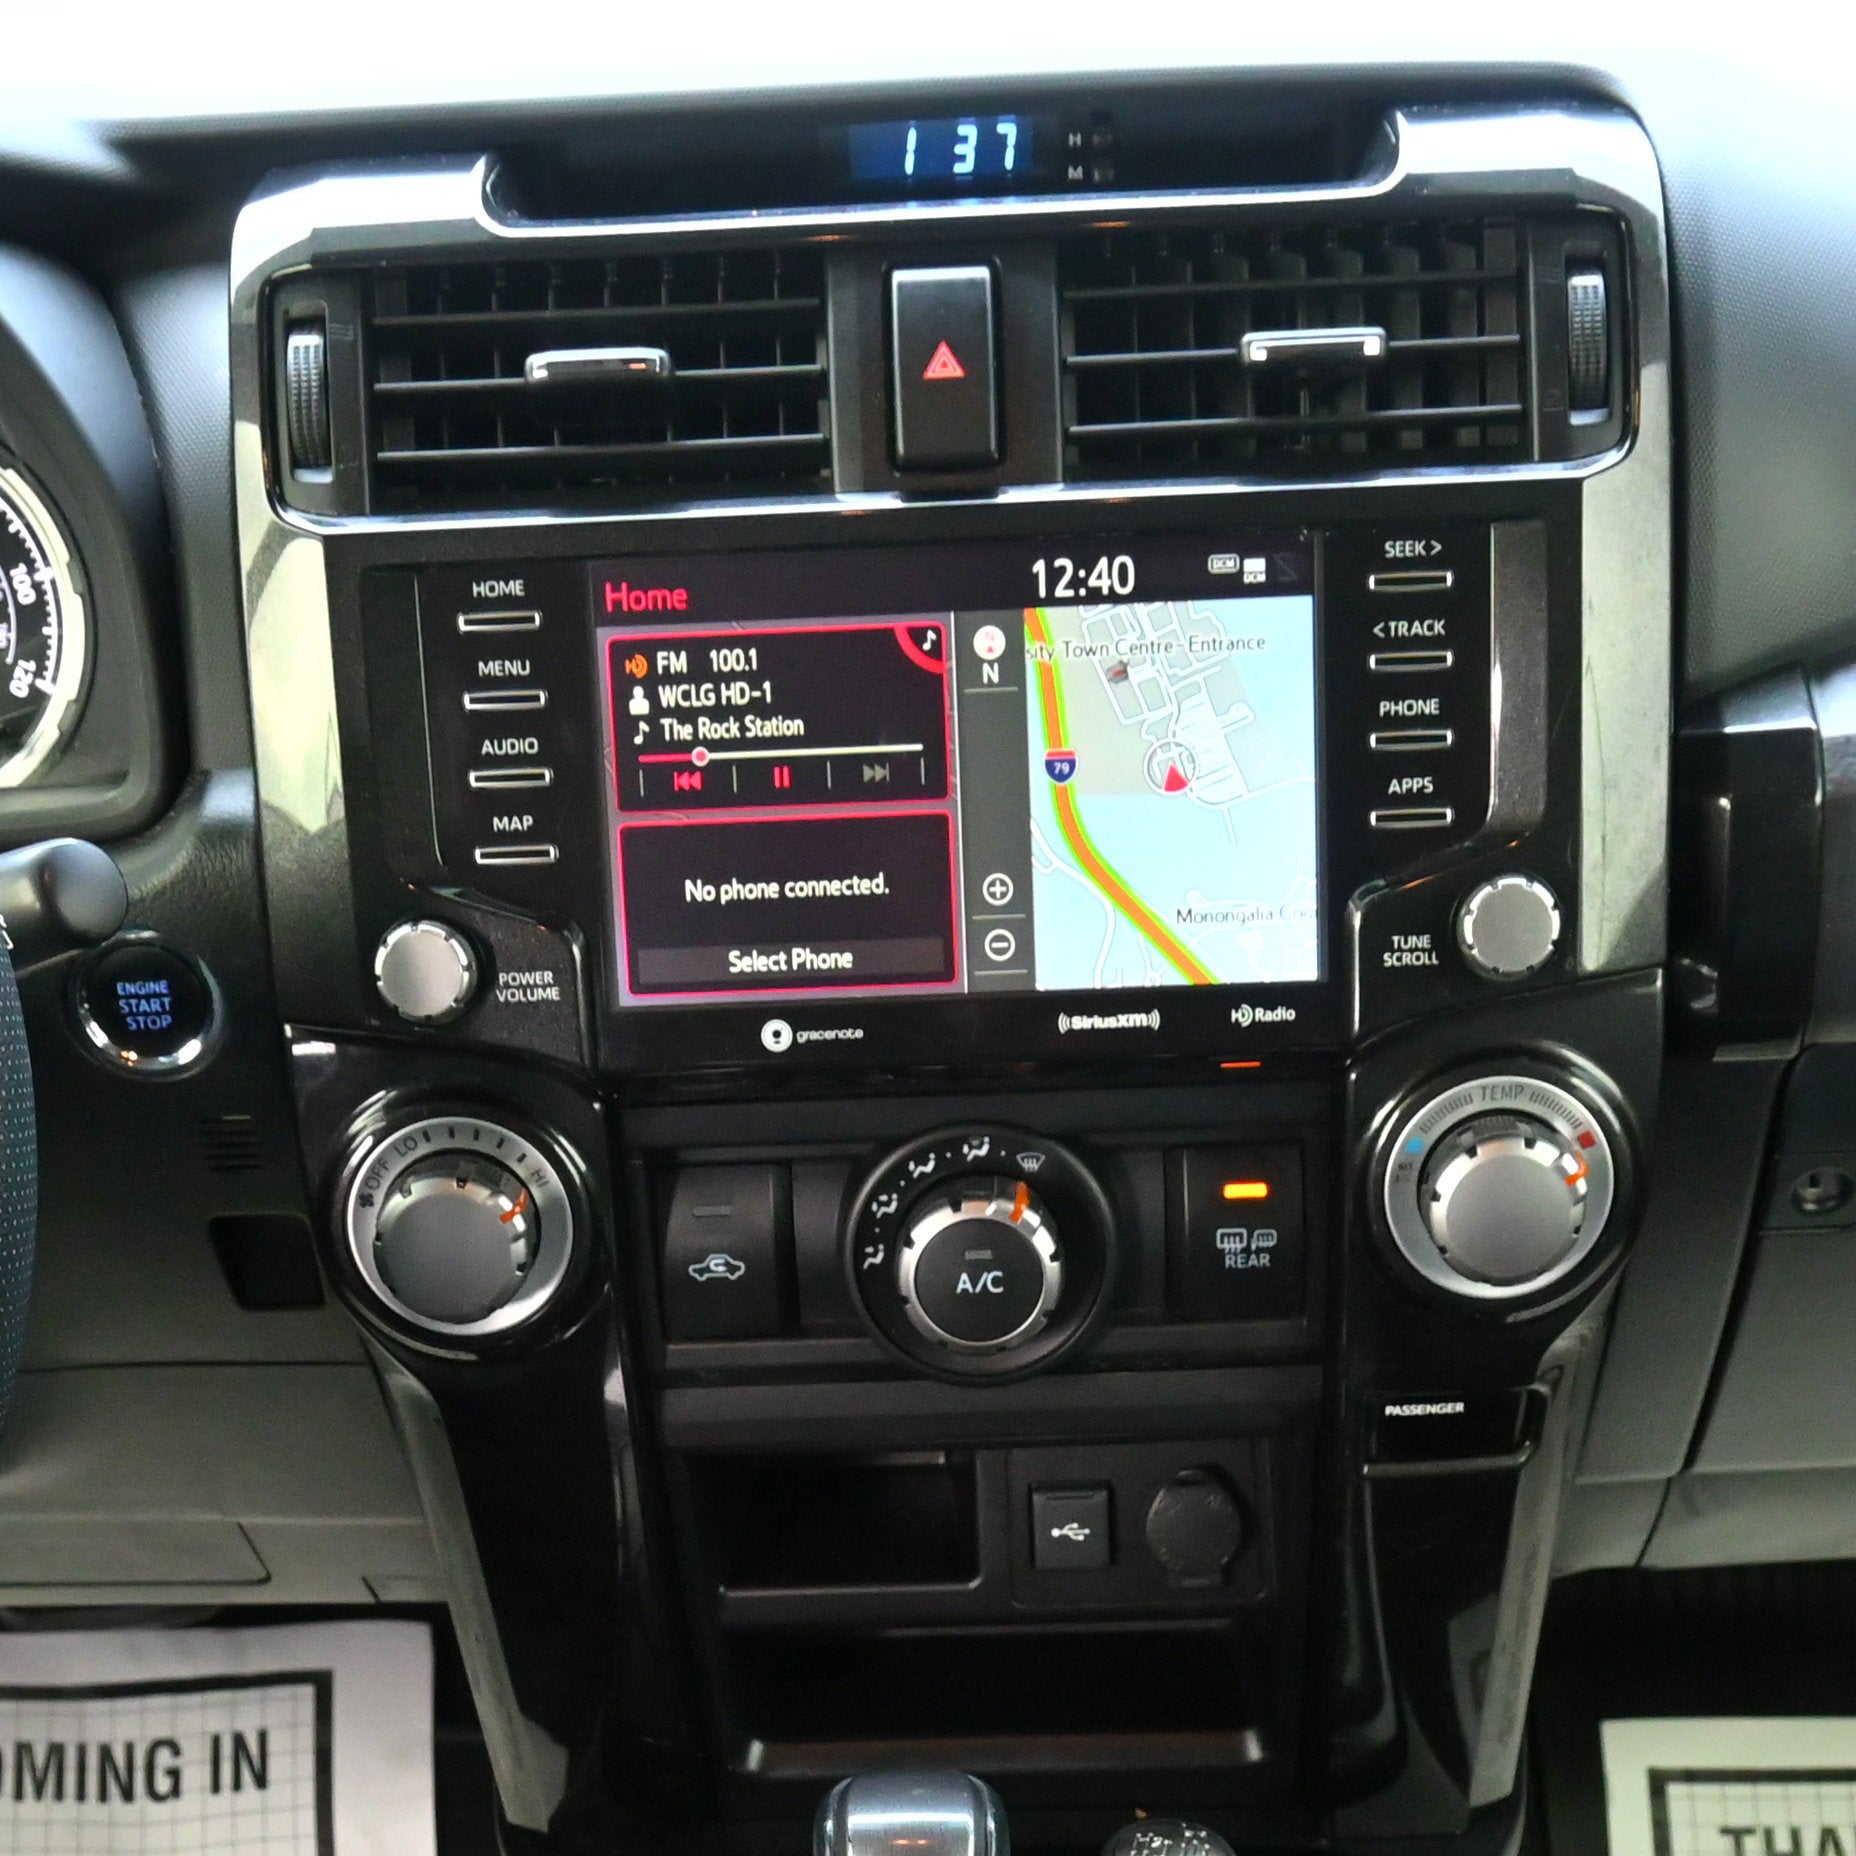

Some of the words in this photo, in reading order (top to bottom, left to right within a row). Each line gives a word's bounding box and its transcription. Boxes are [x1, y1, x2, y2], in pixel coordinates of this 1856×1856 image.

[1384, 540, 1427, 558] SEEK
[9, 563, 37, 606] 100
[1032, 555, 1135, 599] 12:40
[472, 580, 525, 598] HOME
[605, 582, 688, 612] Home
[1388, 619, 1446, 638] TRACK
[1062, 640, 1109, 659] Town
[1115, 638, 1173, 656] Centre
[1189, 635, 1266, 652] Entrance
[478, 659, 531, 677] MENU
[657, 651, 687, 674] FM
[709, 648, 758, 672] 100.1
[9, 659, 37, 699] 120
[982, 662, 999, 684] N
[658, 682, 716, 708] WCLG
[721, 681, 772, 705] HD-1
[1379, 698, 1440, 717] PHONE
[660, 718, 693, 742] The
[698, 716, 740, 740] Rock
[745, 715, 804, 739] Station
[481, 737, 539, 755] AUDIO
[1053, 762, 1070, 774] 79
[1388, 776, 1434, 795] APPS
[492, 815, 533, 832] MAP
[685, 879, 715, 902] No
[720, 877, 779, 905] phone
[784, 871, 890, 898] connected.
[1177, 907, 1273, 926] Monongalia
[1392, 934, 1431, 950] TUNE
[728, 949, 788, 973] Select
[792, 947, 853, 971] Phone
[1383, 950, 1440, 968] SCROLL
[116, 979, 169, 995] ENGINE
[498, 970, 555, 987] POWER
[495, 986, 561, 1003] VOLUME
[118, 997, 172, 1013] START
[1255, 1006, 1295, 1022] Radio
[126, 1014, 173, 1031] STOP
[796, 1028, 864, 1043] gracenote
[1480, 1084, 1525, 1101] TEMP
[394, 1135, 419, 1158] LO
[366, 1156, 391, 1191] OFF
[1224, 1252, 1271, 1268] REAR
[955, 1270, 1004, 1294] A/C
[1384, 1402, 1465, 1417] PASSENGER
[208, 1728, 268, 1796] IN
